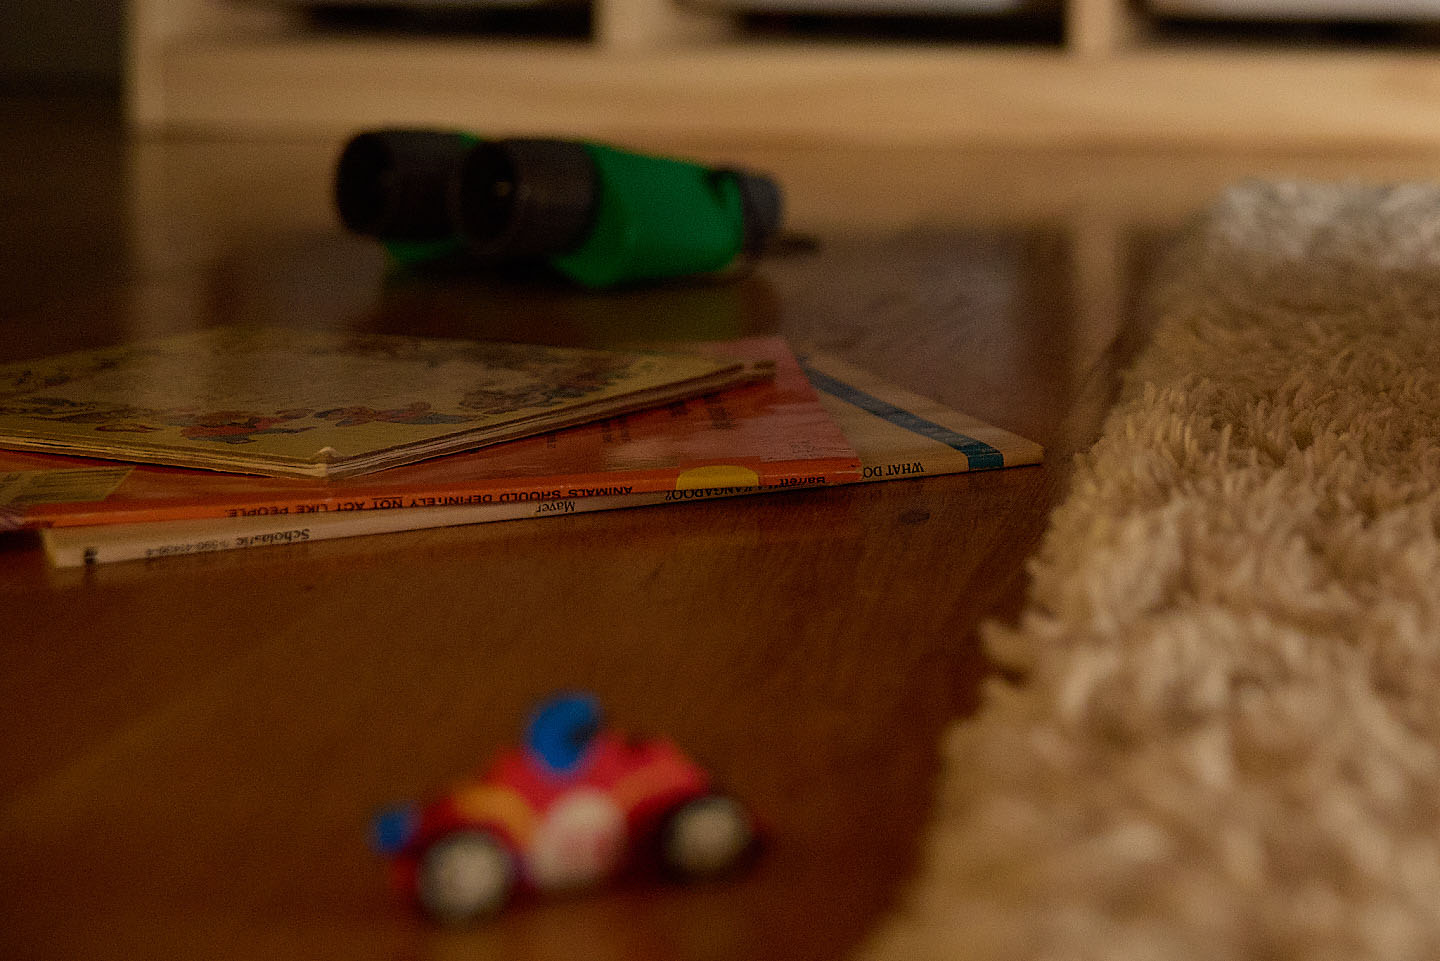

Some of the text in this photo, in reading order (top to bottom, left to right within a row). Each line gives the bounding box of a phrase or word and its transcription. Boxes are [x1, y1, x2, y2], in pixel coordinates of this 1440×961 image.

[863, 466, 882, 478] DO
[886, 462, 925, 476] WHAT
[500, 489, 561, 503] SHOULD
[568, 486, 633, 498] ANIMALS
[336, 502, 365, 512] ACT
[373, 497, 403, 510] NOT
[410, 494, 493, 507] DEFINITELY
[296, 503, 329, 514] LIKE
[236, 528, 311, 546] Scholastic
